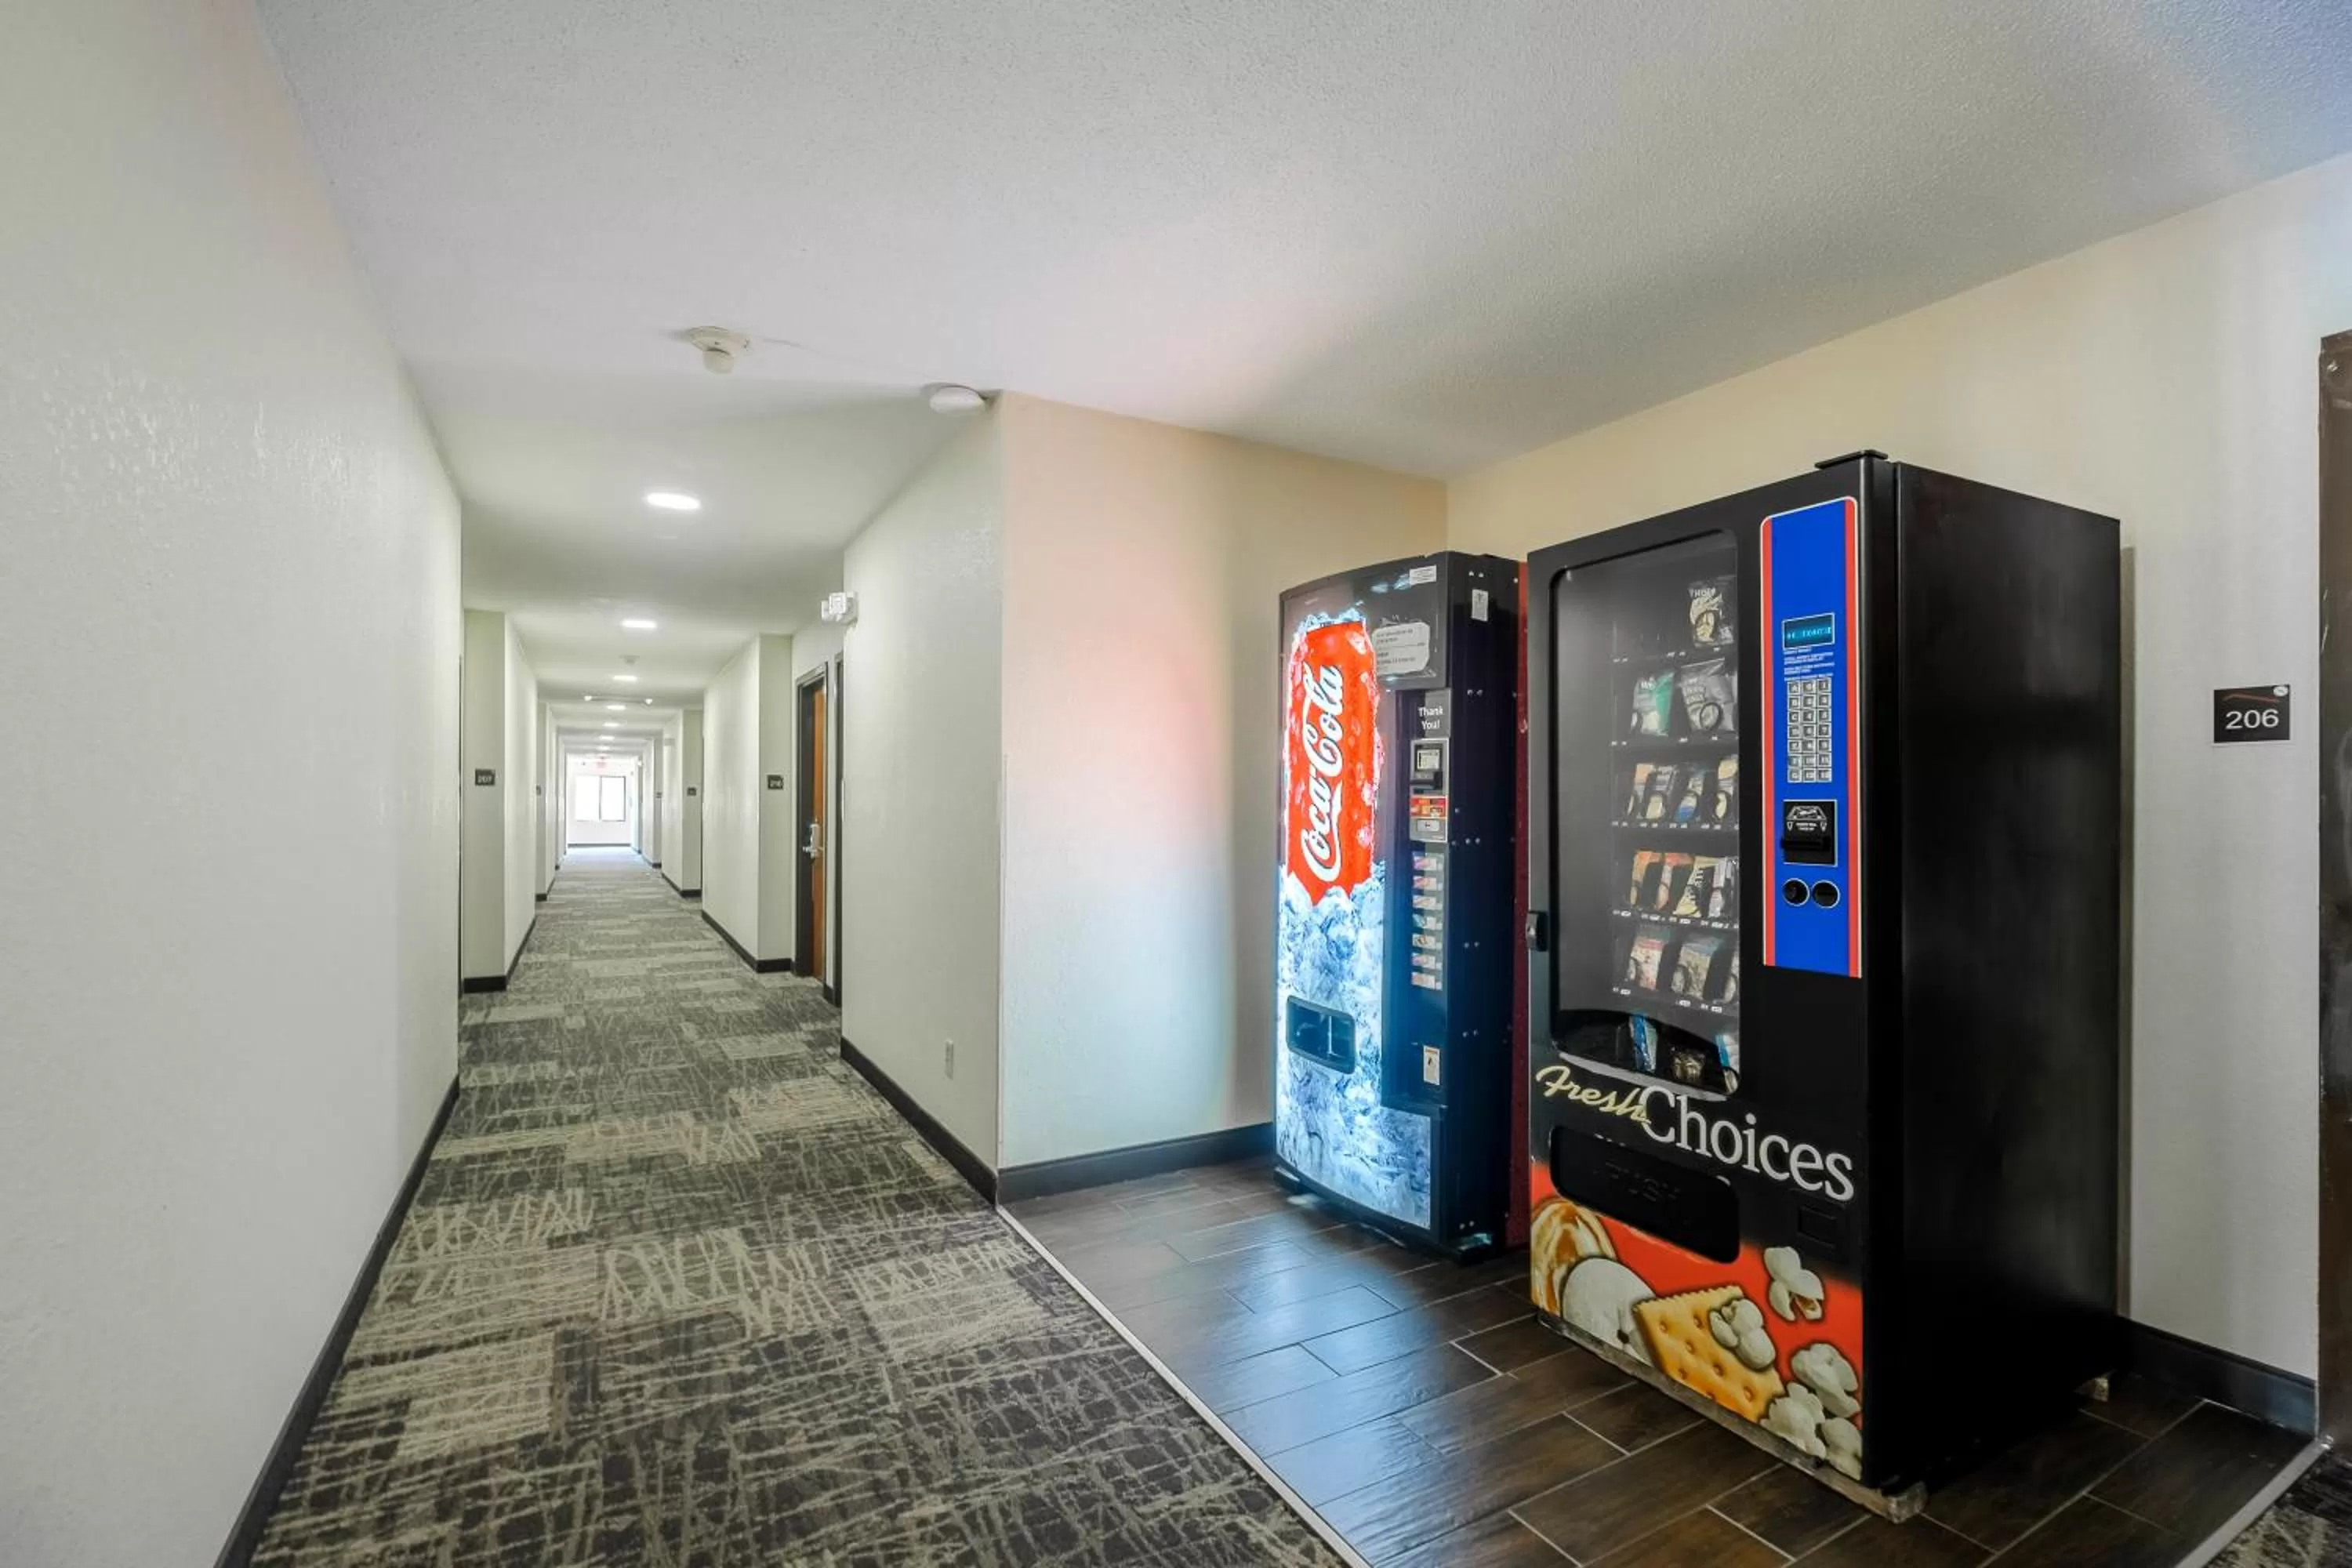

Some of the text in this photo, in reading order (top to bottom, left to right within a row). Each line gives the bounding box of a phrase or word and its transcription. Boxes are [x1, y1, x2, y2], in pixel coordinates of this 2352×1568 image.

[1417, 705, 1444, 717] Thank
[2225, 709, 2279, 729] 206
[1421, 719, 1440, 730] You!
[1301, 662, 1344, 882] Coca-Cola
[1536, 1065, 1652, 1125] Fresh
[1640, 1085, 1854, 1202] Choices
